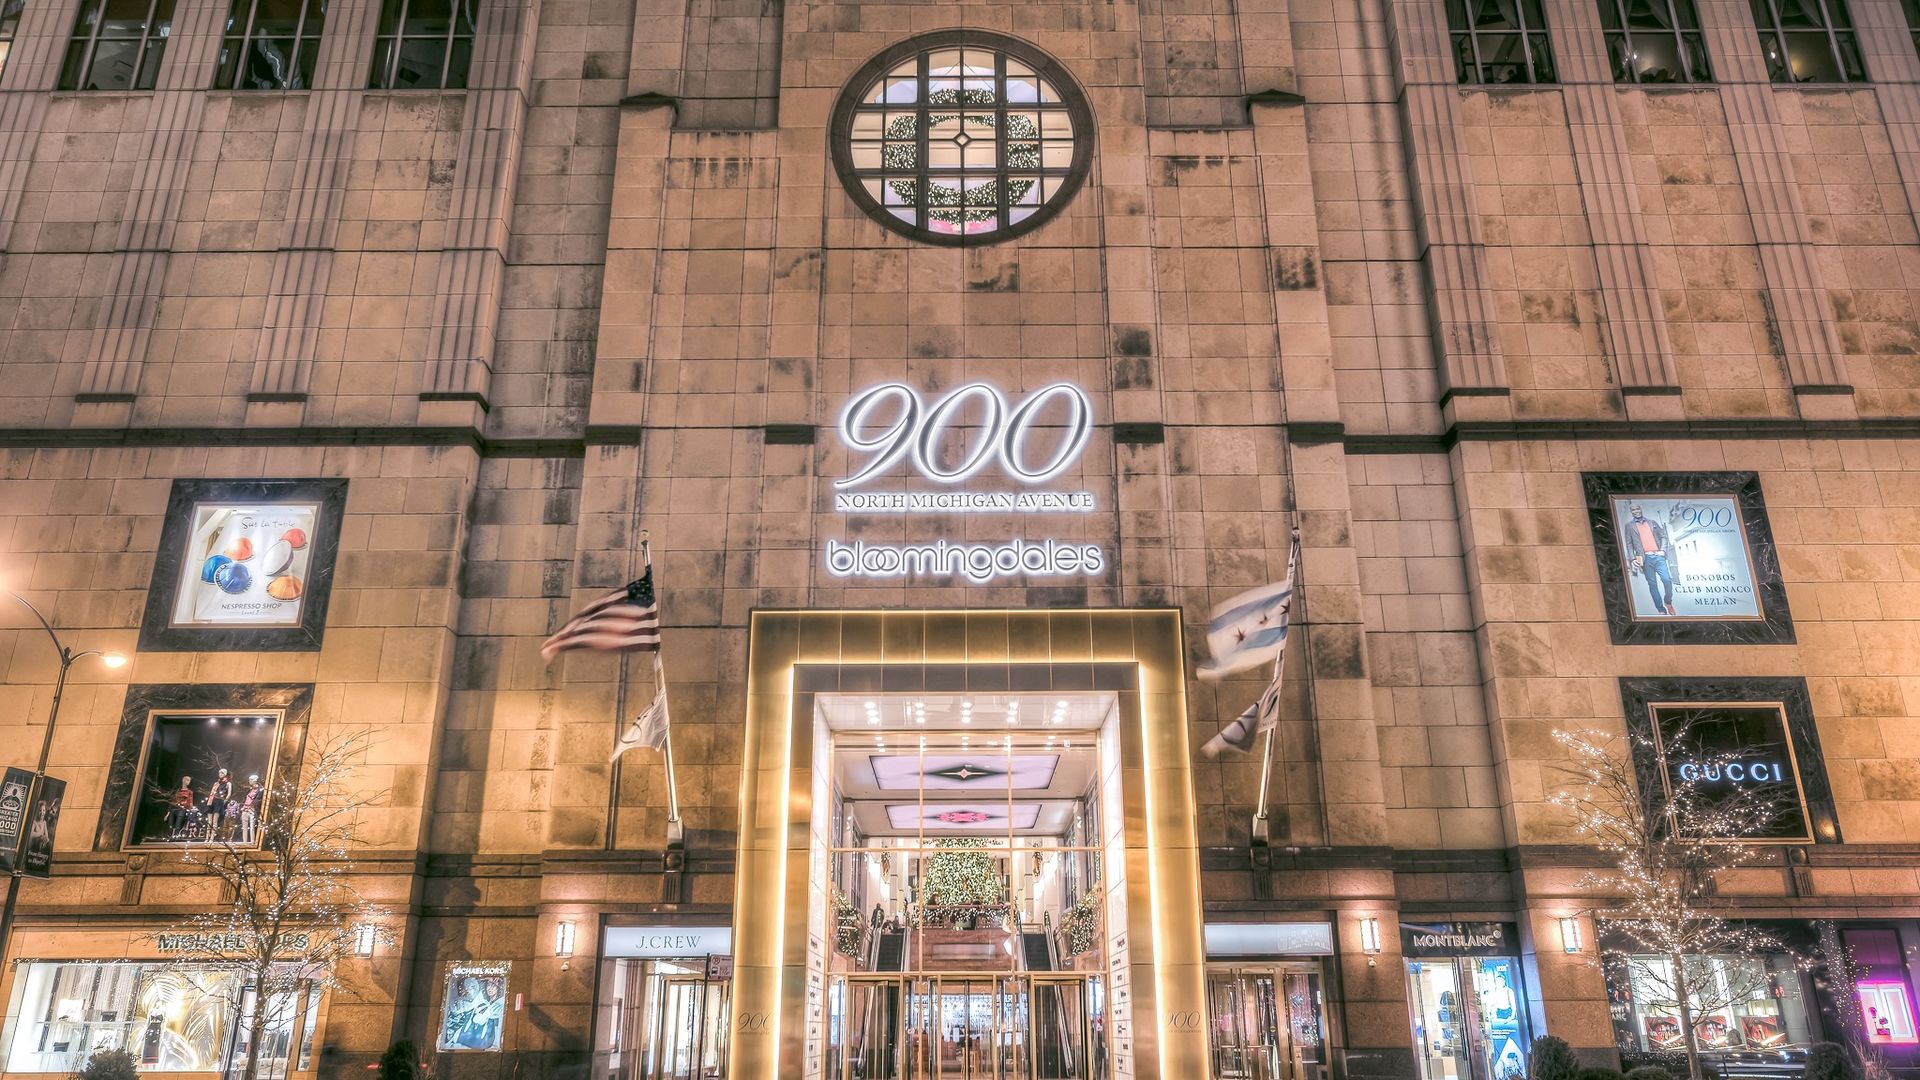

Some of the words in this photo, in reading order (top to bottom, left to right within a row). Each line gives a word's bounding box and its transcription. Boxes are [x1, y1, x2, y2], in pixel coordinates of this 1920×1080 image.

[836, 384, 1088, 486] 900
[837, 494, 905, 508] NORTH
[911, 494, 1013, 508] MICHIGAN
[1017, 494, 1093, 507] AVENUE
[1682, 507, 1731, 527] 900
[830, 540, 1101, 579] bloomingdale's
[1680, 763, 1781, 781] GUCCI
[158, 934, 246, 950] MICHAEL
[636, 936, 701, 949] J.CREW
[1413, 934, 1497, 947] MONTBLANC
